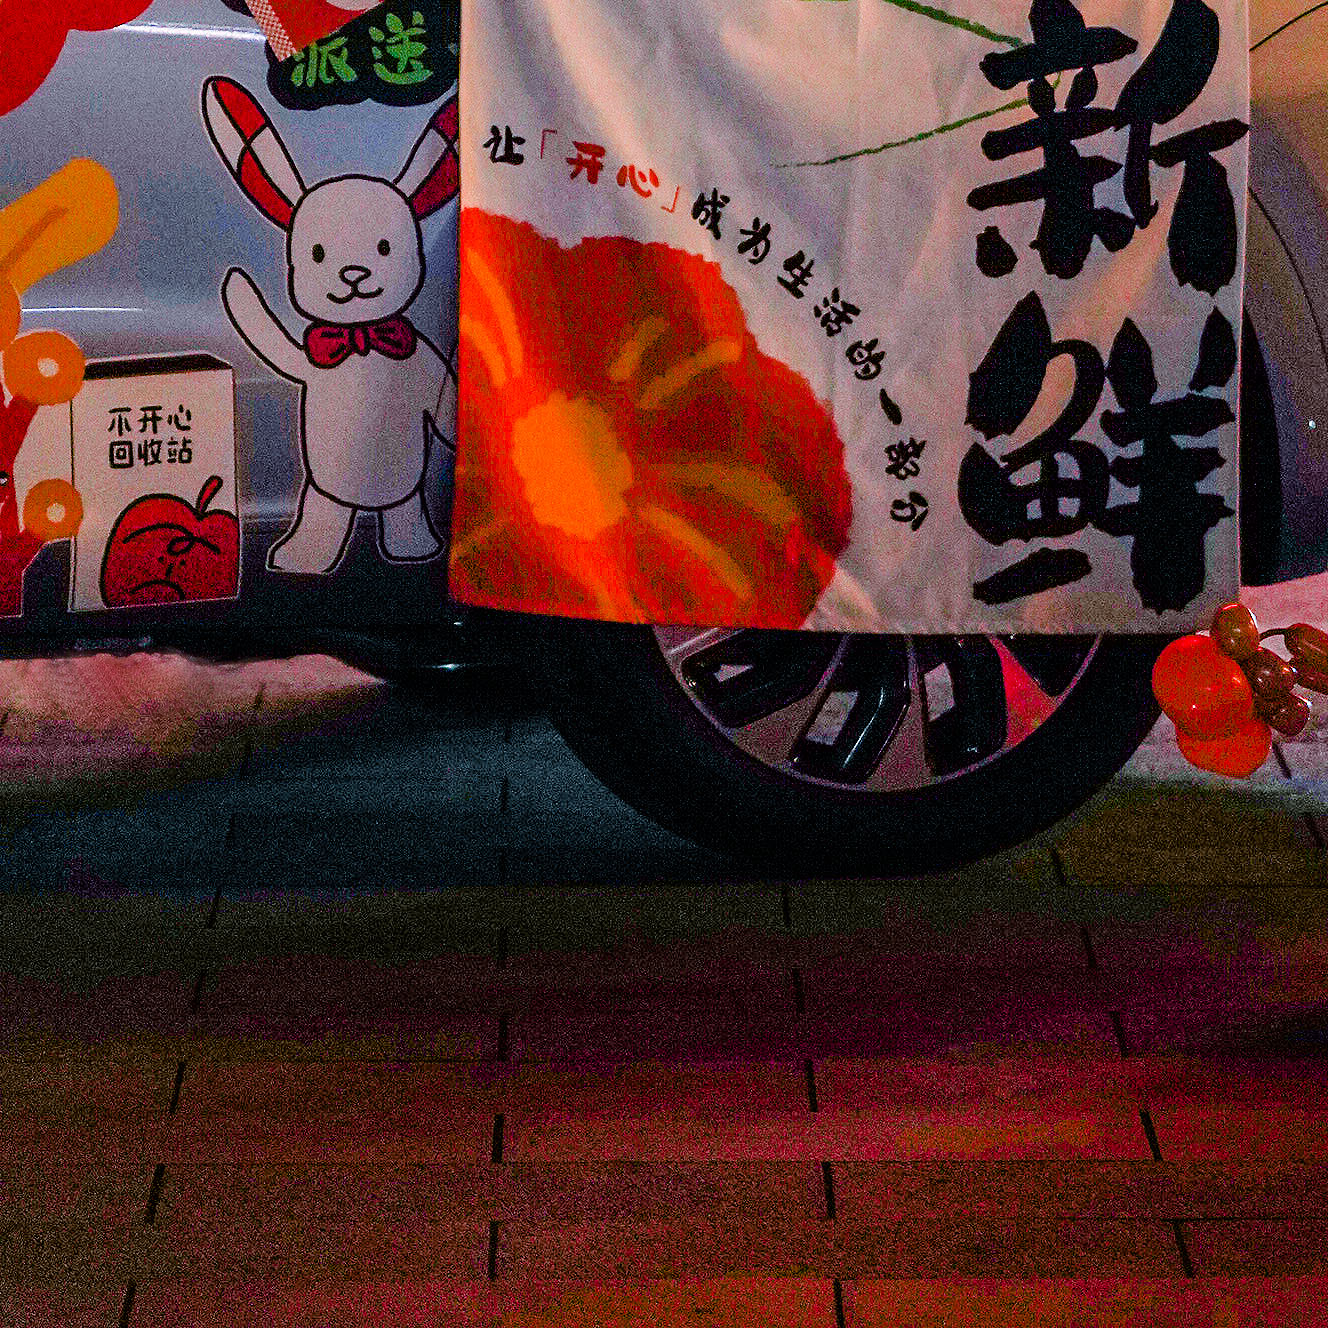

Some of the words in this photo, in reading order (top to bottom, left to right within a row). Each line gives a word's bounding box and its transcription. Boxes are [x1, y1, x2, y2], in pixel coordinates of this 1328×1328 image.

[291, 10, 434, 88] 派送
[107, 404, 192, 436] 不开心
[108, 437, 193, 469] 回收站
